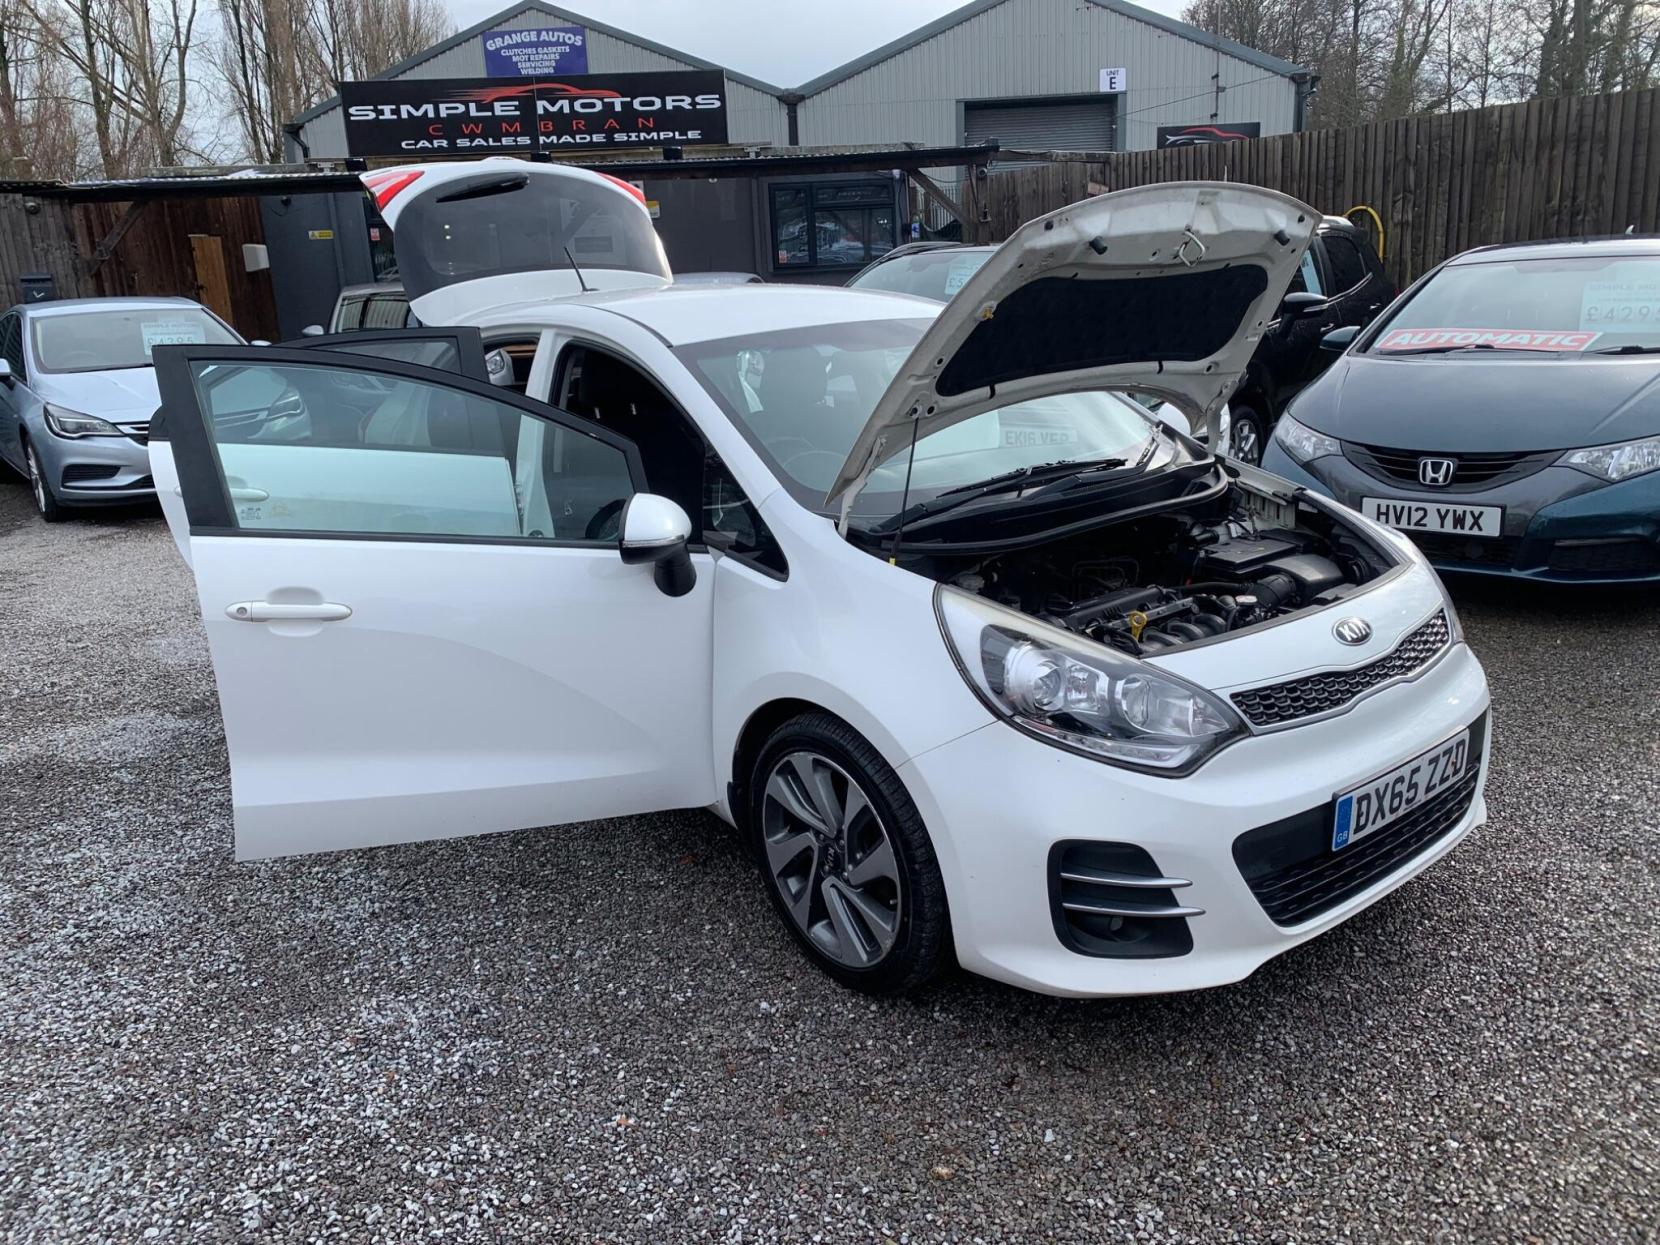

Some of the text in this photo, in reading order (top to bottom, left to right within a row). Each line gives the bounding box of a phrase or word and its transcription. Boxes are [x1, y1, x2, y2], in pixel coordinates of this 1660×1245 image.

[486, 30, 583, 50] GRANGE AUTOS
[501, 47, 537, 56] CLUTCHES
[512, 53, 560, 62] MOT REPAIRS
[517, 60, 556, 68] SERVICING
[520, 67, 554, 75] WELDING
[1109, 76, 1116, 90] E
[349, 94, 722, 120] SIMPLE MOTORS
[429, 117, 654, 136] CWMBRAN
[401, 130, 702, 149] CAR SALES MADE SIMPLE
[1391, 331, 1587, 347] AUTOMATIC
[1376, 504, 1484, 531] HV12 YWX
[1338, 620, 1370, 641] KIA
[1353, 738, 1466, 835] DX65 ZZD
[1337, 830, 1348, 842] GB
